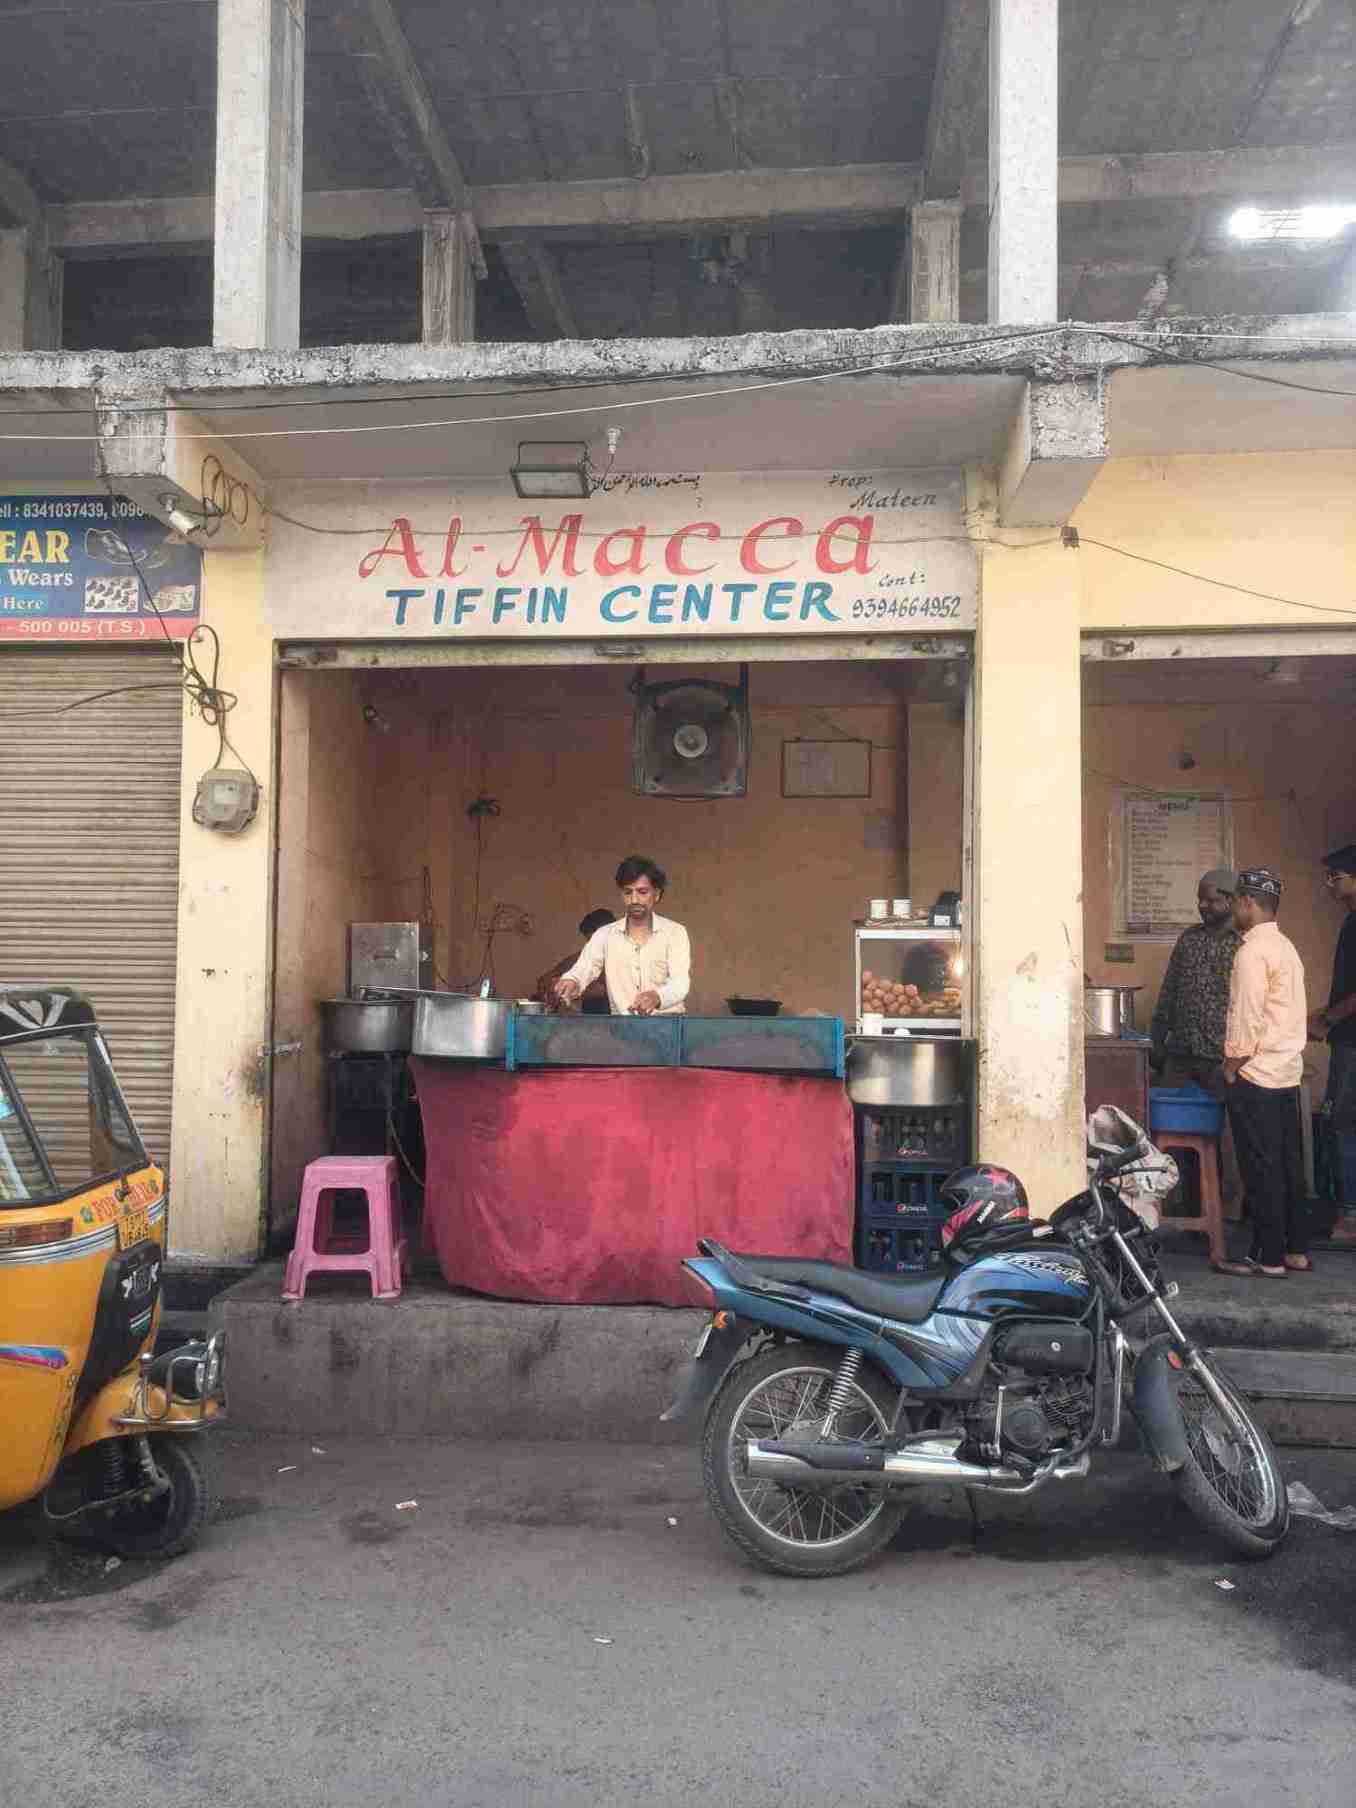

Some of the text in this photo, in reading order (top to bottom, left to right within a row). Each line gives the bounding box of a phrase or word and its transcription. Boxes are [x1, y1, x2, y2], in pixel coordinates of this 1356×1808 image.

[8, 568, 73, 587] Wears
[3, 595, 43, 609] Here
[386, 581, 842, 625] TIFFIN CENTER
[19, 620, 52, 633] 500
[58, 620, 91, 633] 005
